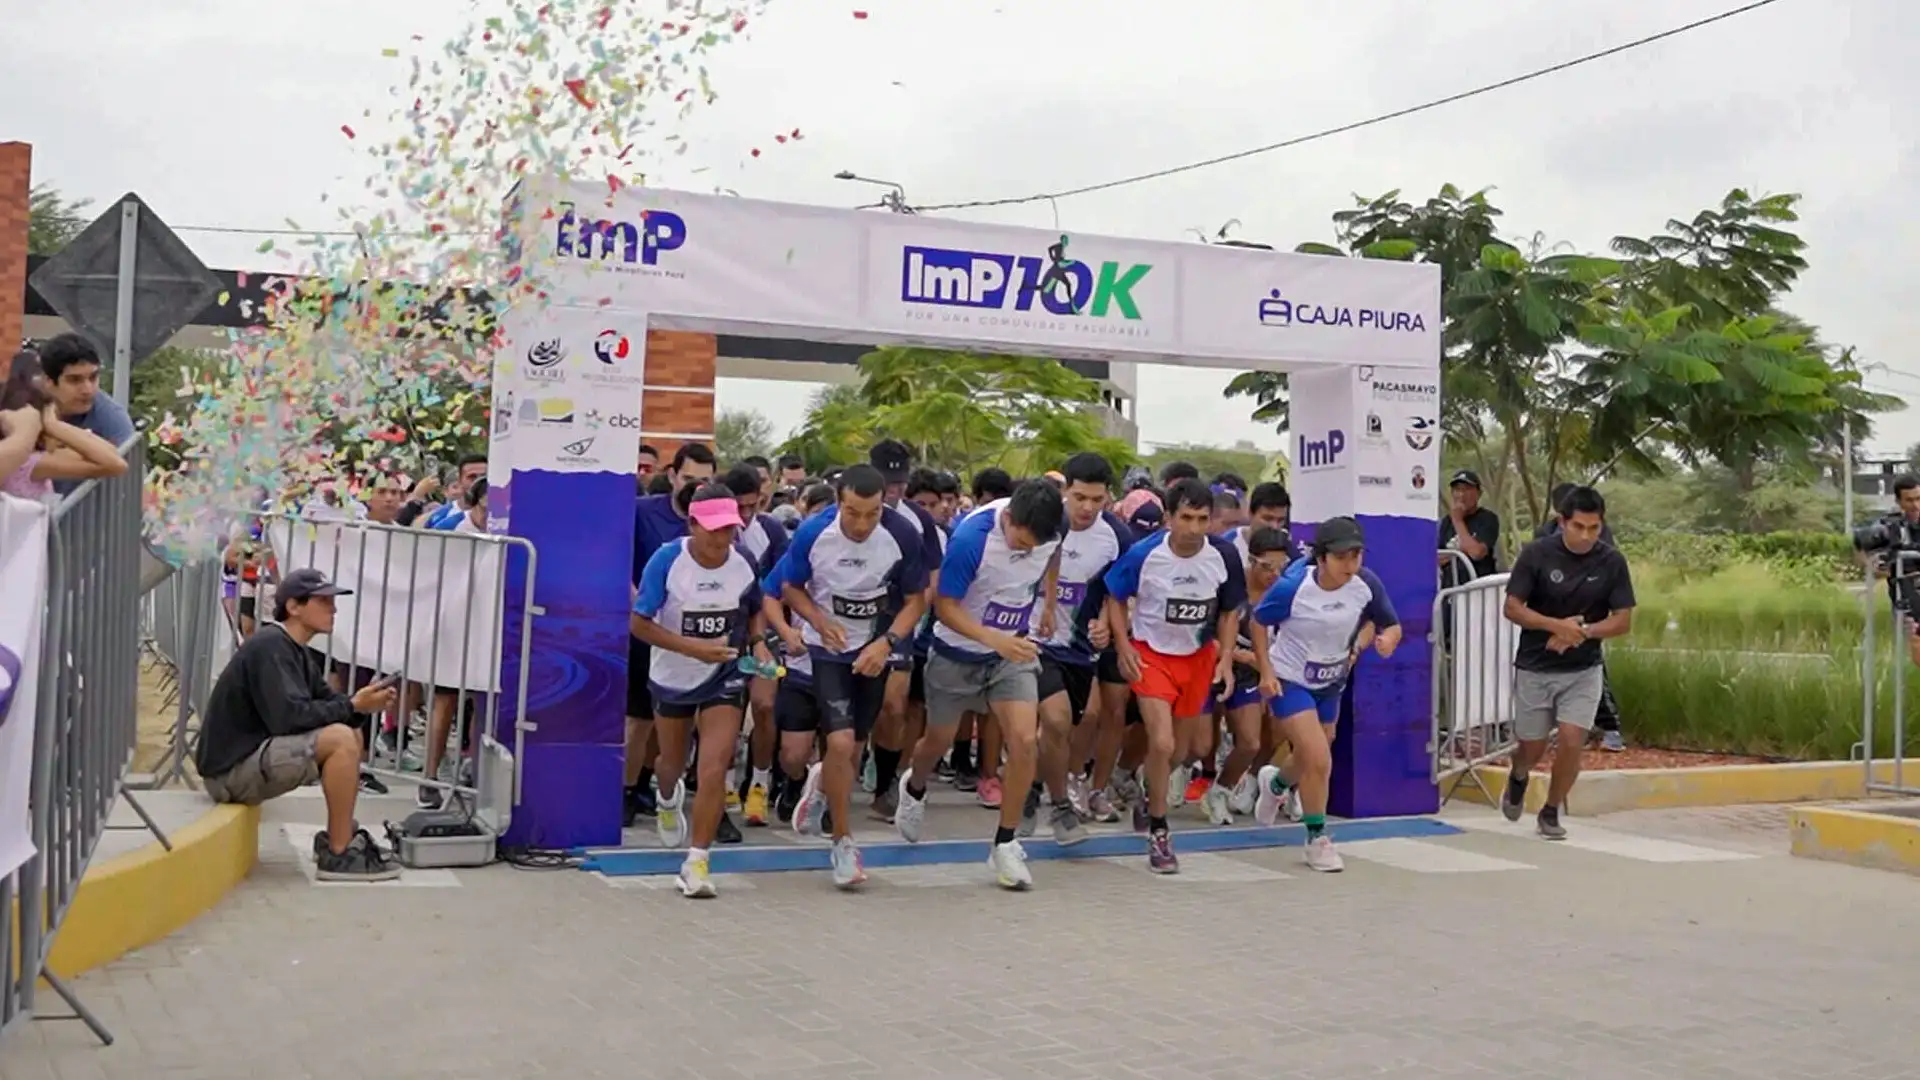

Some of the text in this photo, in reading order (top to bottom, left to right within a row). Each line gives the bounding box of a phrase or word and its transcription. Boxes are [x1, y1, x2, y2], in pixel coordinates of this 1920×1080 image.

[905, 310, 934, 321] POR
[942, 313, 970, 324] UNA
[979, 316, 1066, 331] COMUNIDAD
[1295, 303, 1426, 332] CAJA PIURA
[1372, 381, 1437, 394] PACASMAYO
[608, 413, 640, 428] cbc
[1299, 429, 1345, 467] ImP
[846, 603, 878, 616] 225
[1178, 604, 1208, 619] 228
[697, 616, 726, 633] 193
